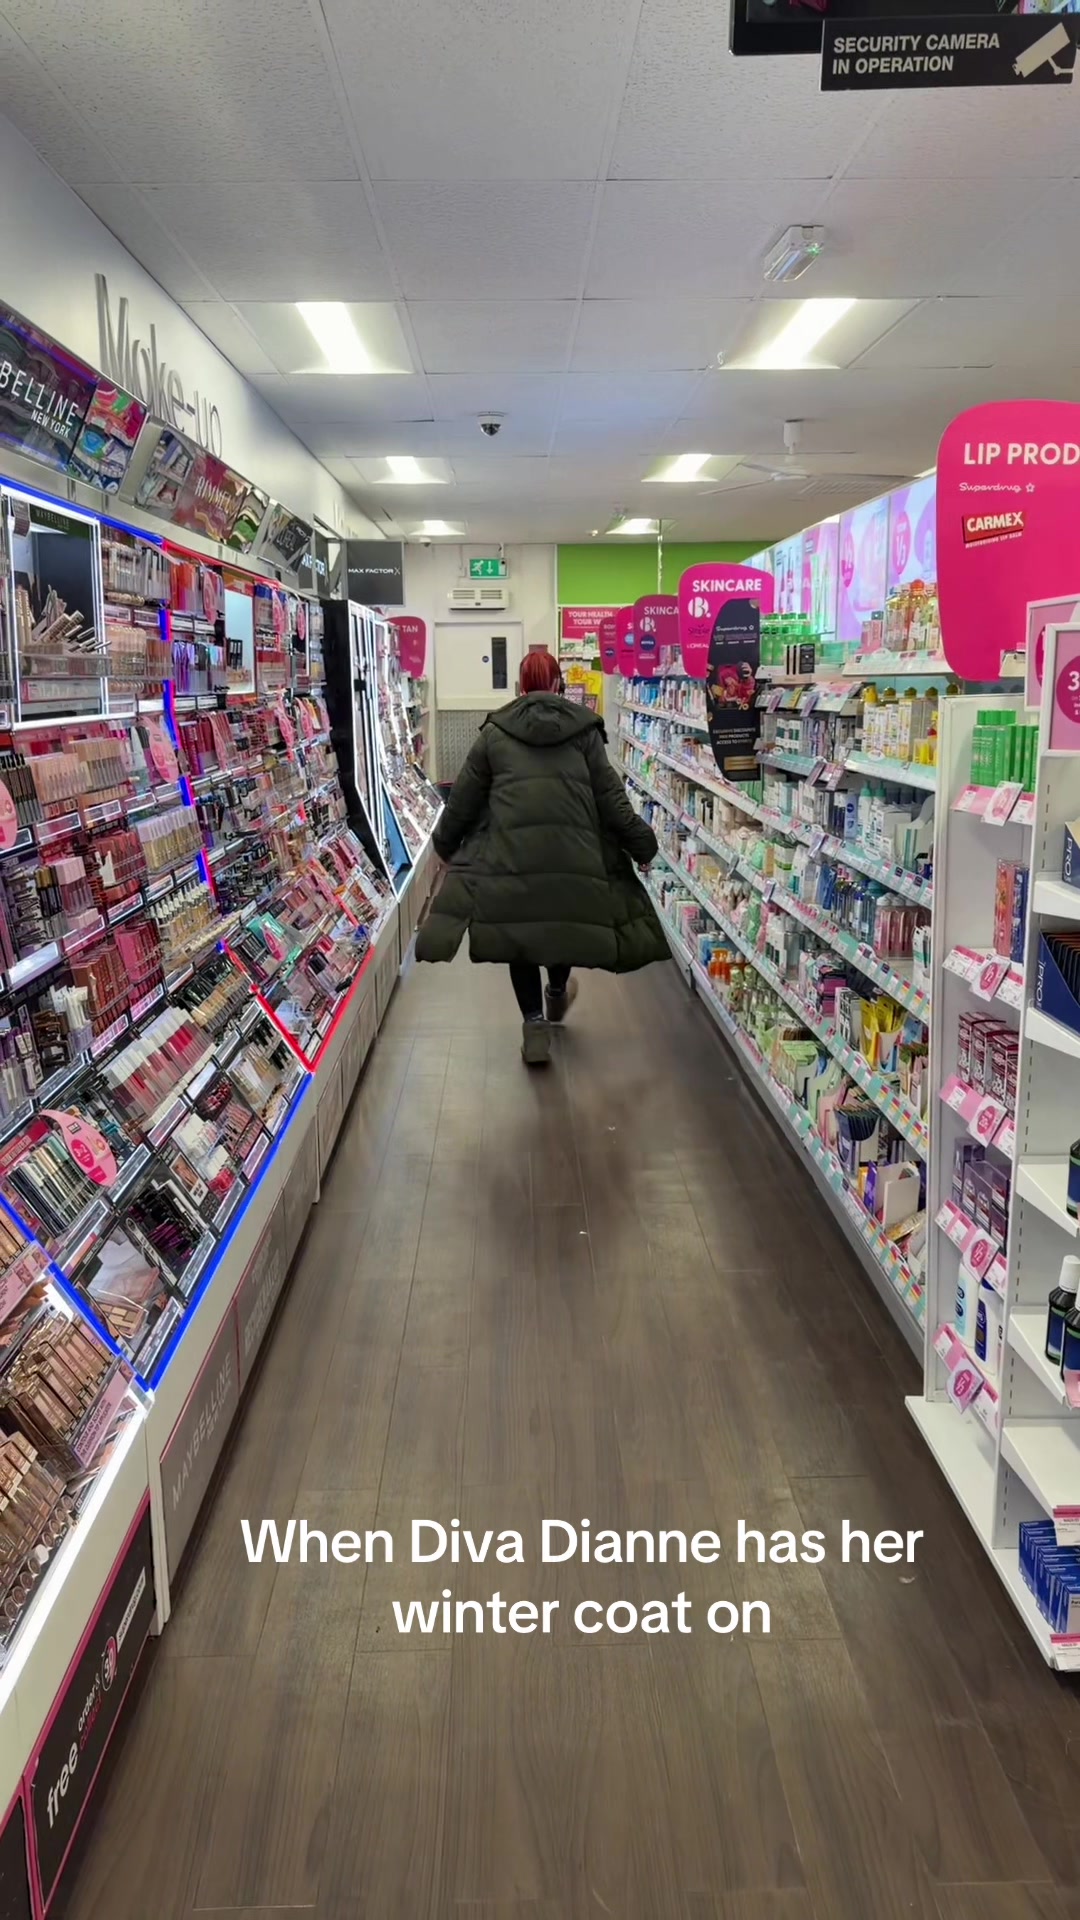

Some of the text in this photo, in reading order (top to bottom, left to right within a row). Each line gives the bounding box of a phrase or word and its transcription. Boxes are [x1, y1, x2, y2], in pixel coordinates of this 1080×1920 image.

[833, 33, 1000, 54] SECURITY CAMERA
[832, 55, 954, 75] IN OPERATION
[31, 410, 71, 438] NEW YORK
[964, 443, 1080, 465] LIP PROD
[195, 476, 231, 514] RIMMEL
[959, 482, 1022, 493] Superdrug
[966, 511, 1024, 532] CARMEX
[692, 579, 762, 593] SKINCARE
[402, 624, 418, 633] TAN
[172, 1354, 233, 1508] MAYBELLINE
[78, 1684, 97, 1731] order
[47, 1742, 78, 1828] free
